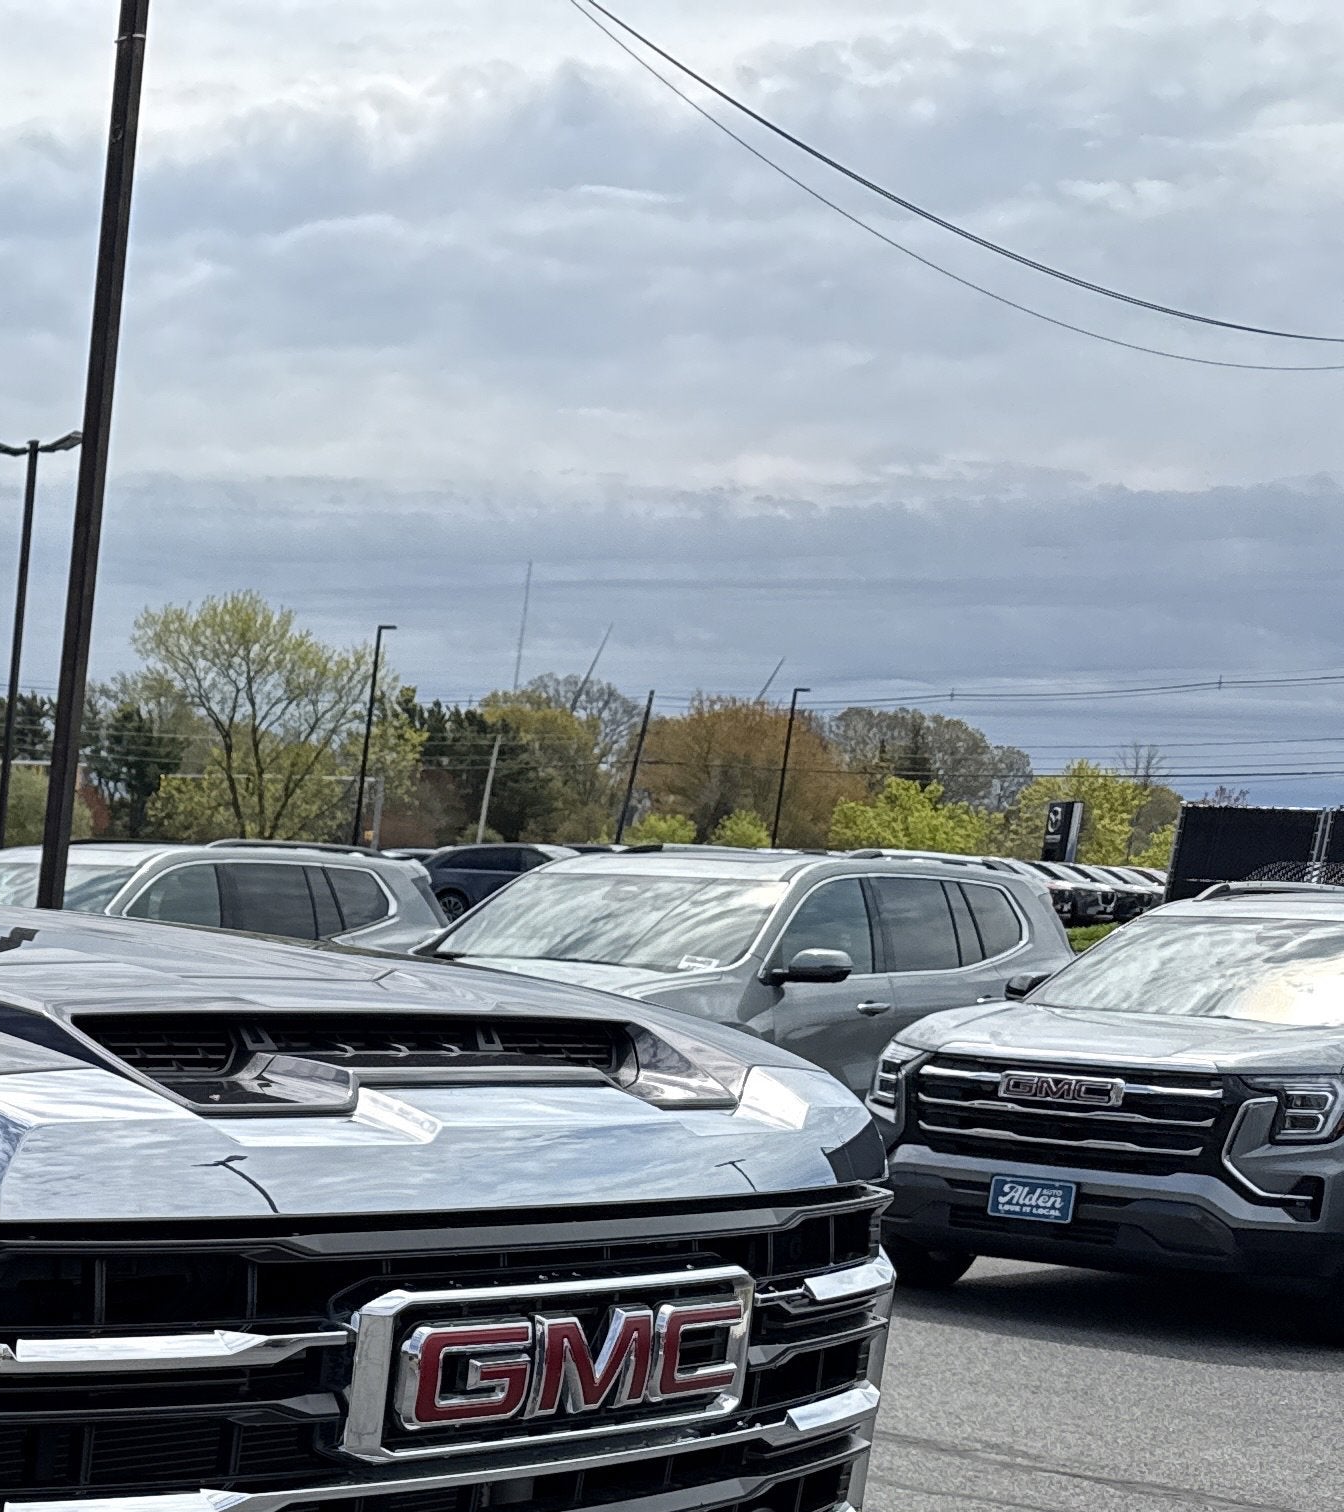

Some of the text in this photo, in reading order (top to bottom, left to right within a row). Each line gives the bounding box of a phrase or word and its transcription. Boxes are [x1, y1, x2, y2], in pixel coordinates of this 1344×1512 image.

[1005, 1076, 1112, 1102] GMC
[998, 1183, 1064, 1209] Alden
[998, 1203, 1062, 1216] LOVE IT LOCAL
[395, 1299, 745, 1430] GMC
